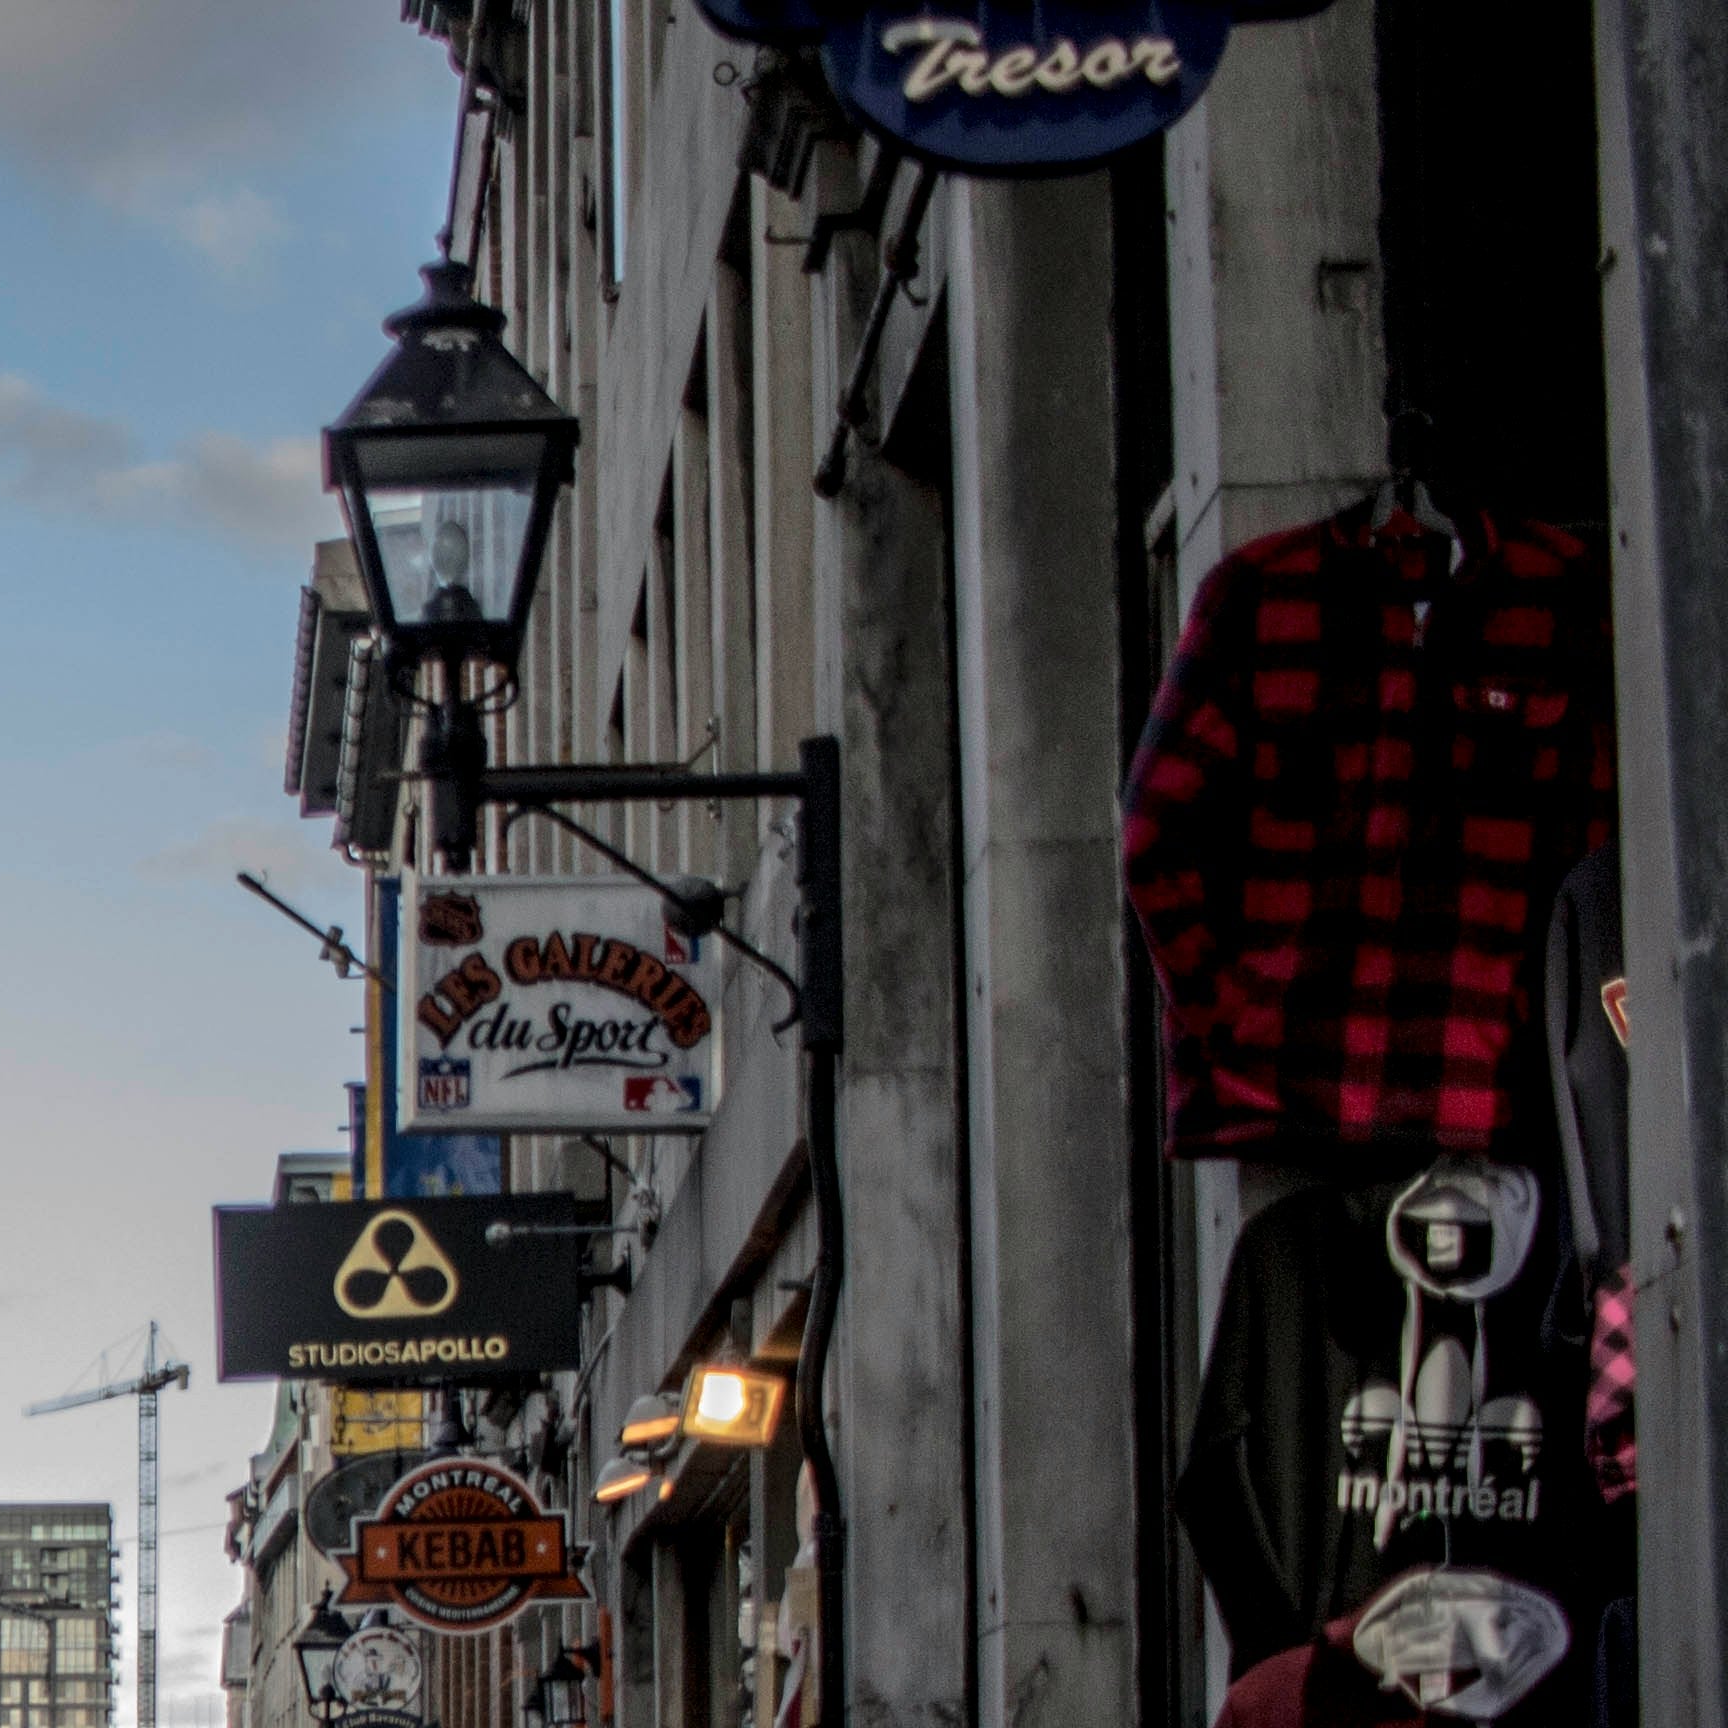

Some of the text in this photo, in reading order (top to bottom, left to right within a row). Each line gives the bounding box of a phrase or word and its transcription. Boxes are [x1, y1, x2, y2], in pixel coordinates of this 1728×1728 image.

[880, 17, 1182, 103] Tresor
[418, 931, 711, 1050] LES GALERIES
[469, 1004, 662, 1069] du Sport
[395, 1469, 526, 1518] MONTREAL
[1336, 1474, 1542, 1522] montréal
[396, 1528, 527, 1570] KEBAB
